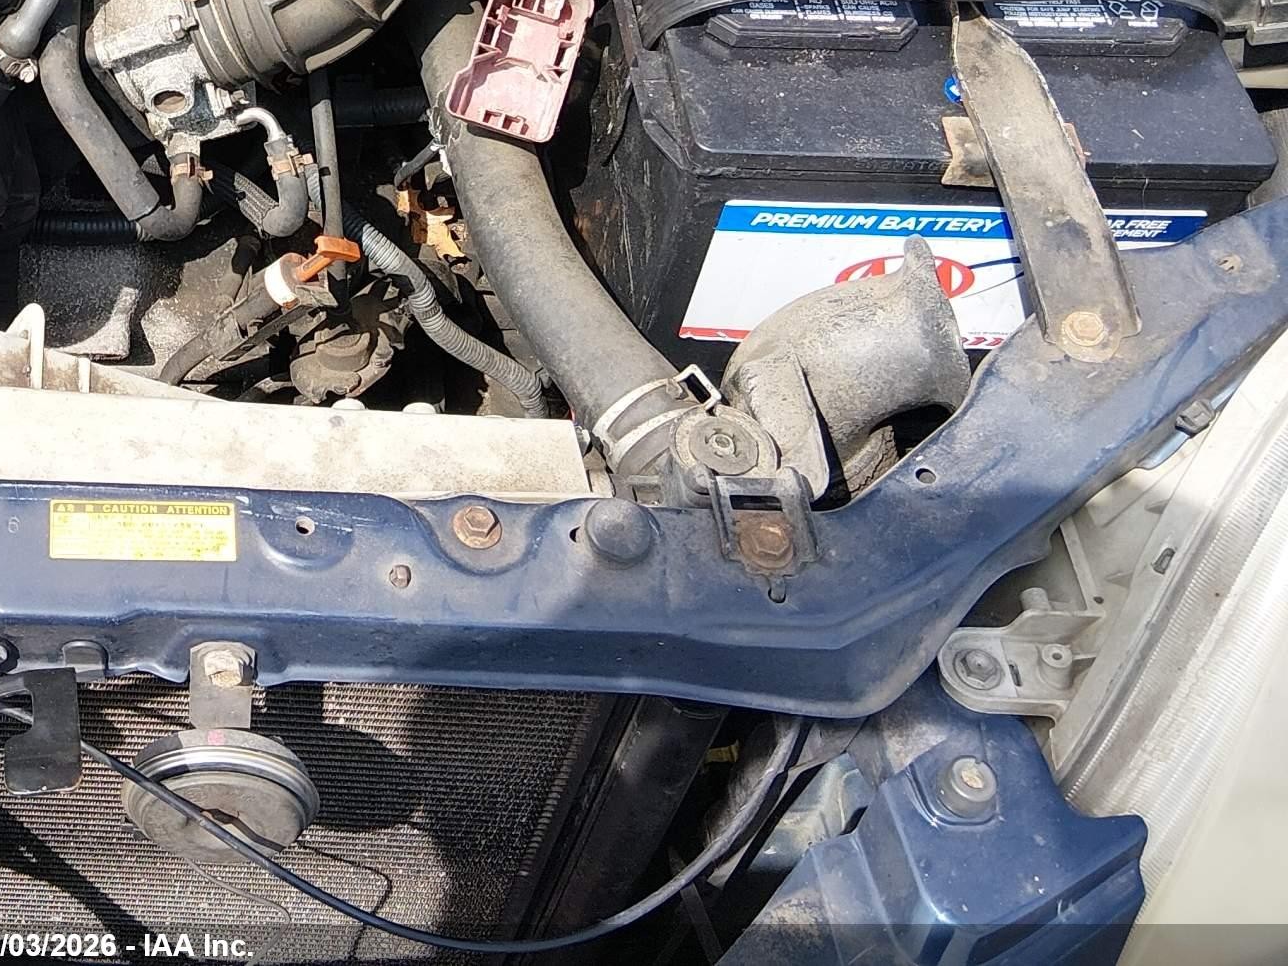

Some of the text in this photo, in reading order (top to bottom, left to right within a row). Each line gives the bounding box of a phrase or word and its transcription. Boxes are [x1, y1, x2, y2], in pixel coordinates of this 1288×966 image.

[750, 211, 1003, 234] PREMIUM BATTERY
[1125, 219, 1173, 230] FREE
[102, 505, 158, 514] CAUTION
[166, 505, 228, 515] ATTENTION
